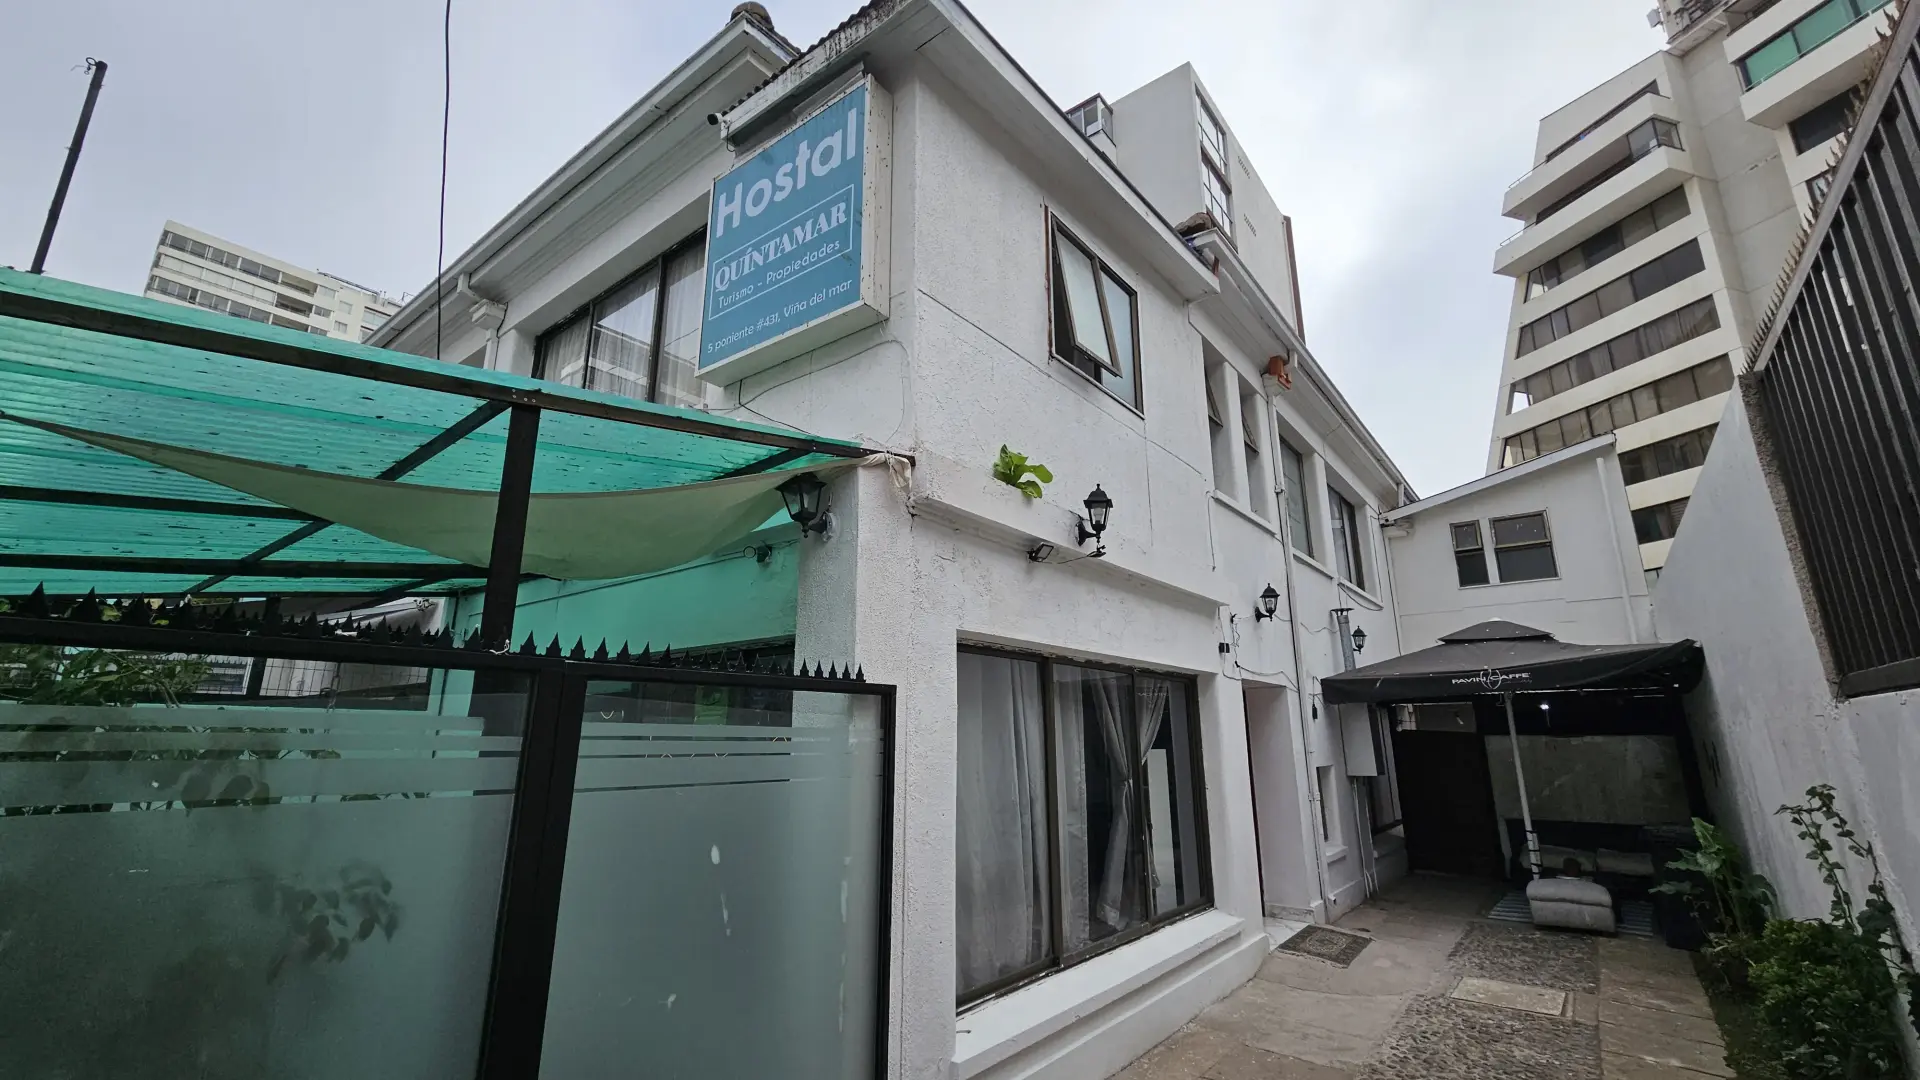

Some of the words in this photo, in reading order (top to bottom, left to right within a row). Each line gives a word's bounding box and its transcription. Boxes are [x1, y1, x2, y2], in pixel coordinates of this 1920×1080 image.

[715, 107, 857, 238] Hostal
[718, 284, 754, 309] Turismo
[766, 240, 840, 285] Propiedades
[707, 343, 714, 354] 5
[714, 325, 755, 352] poniente
[783, 299, 807, 318] Viña
[809, 288, 826, 306] del
[828, 279, 853, 298] mar
